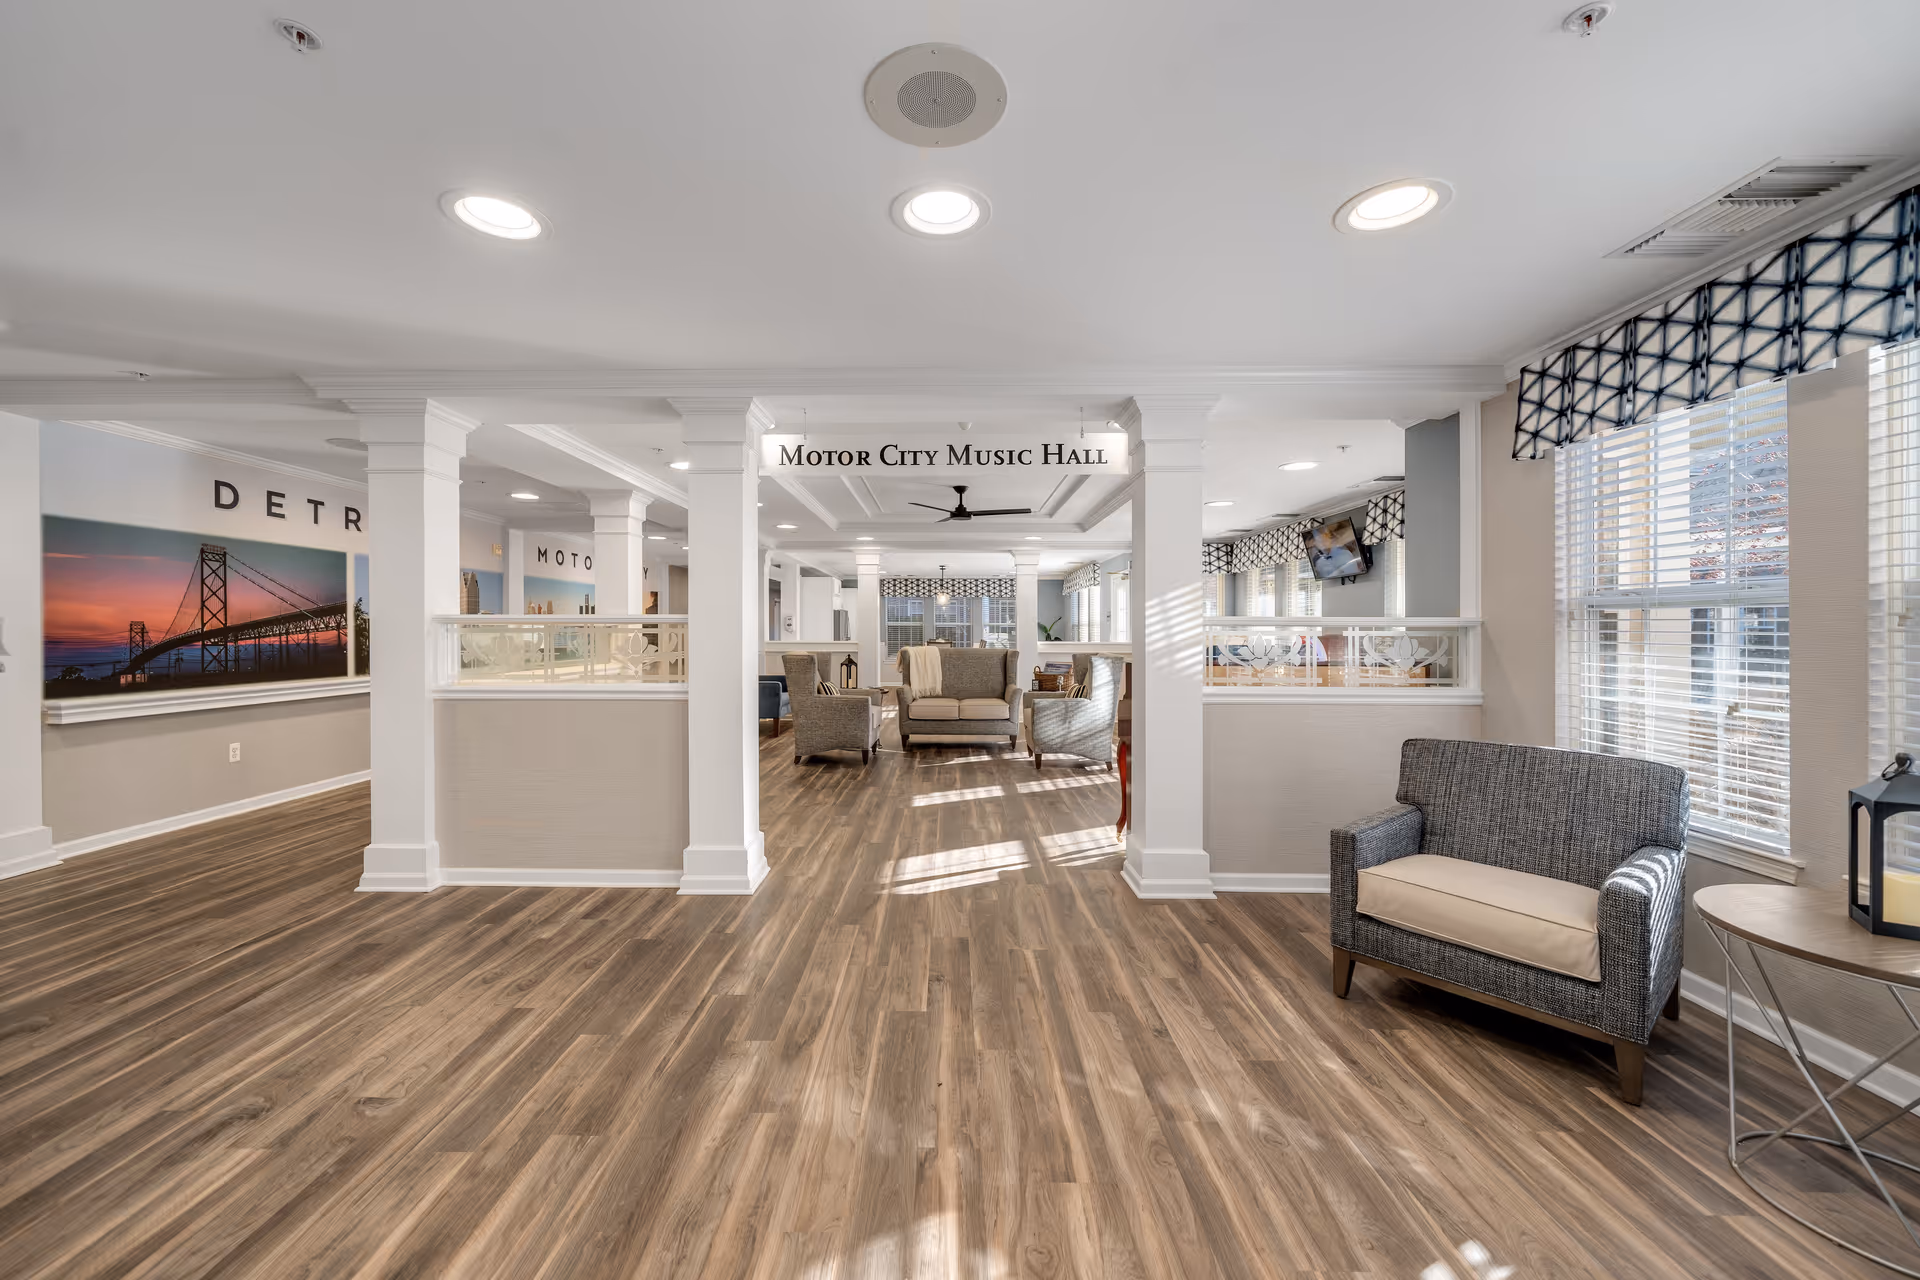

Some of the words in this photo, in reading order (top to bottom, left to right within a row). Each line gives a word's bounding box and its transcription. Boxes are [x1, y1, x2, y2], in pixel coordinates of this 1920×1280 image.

[778, 444, 872, 467] MOTOR
[879, 443, 939, 467] CITY
[946, 444, 1032, 467] MUSIC
[1041, 443, 1108, 465] HALL
